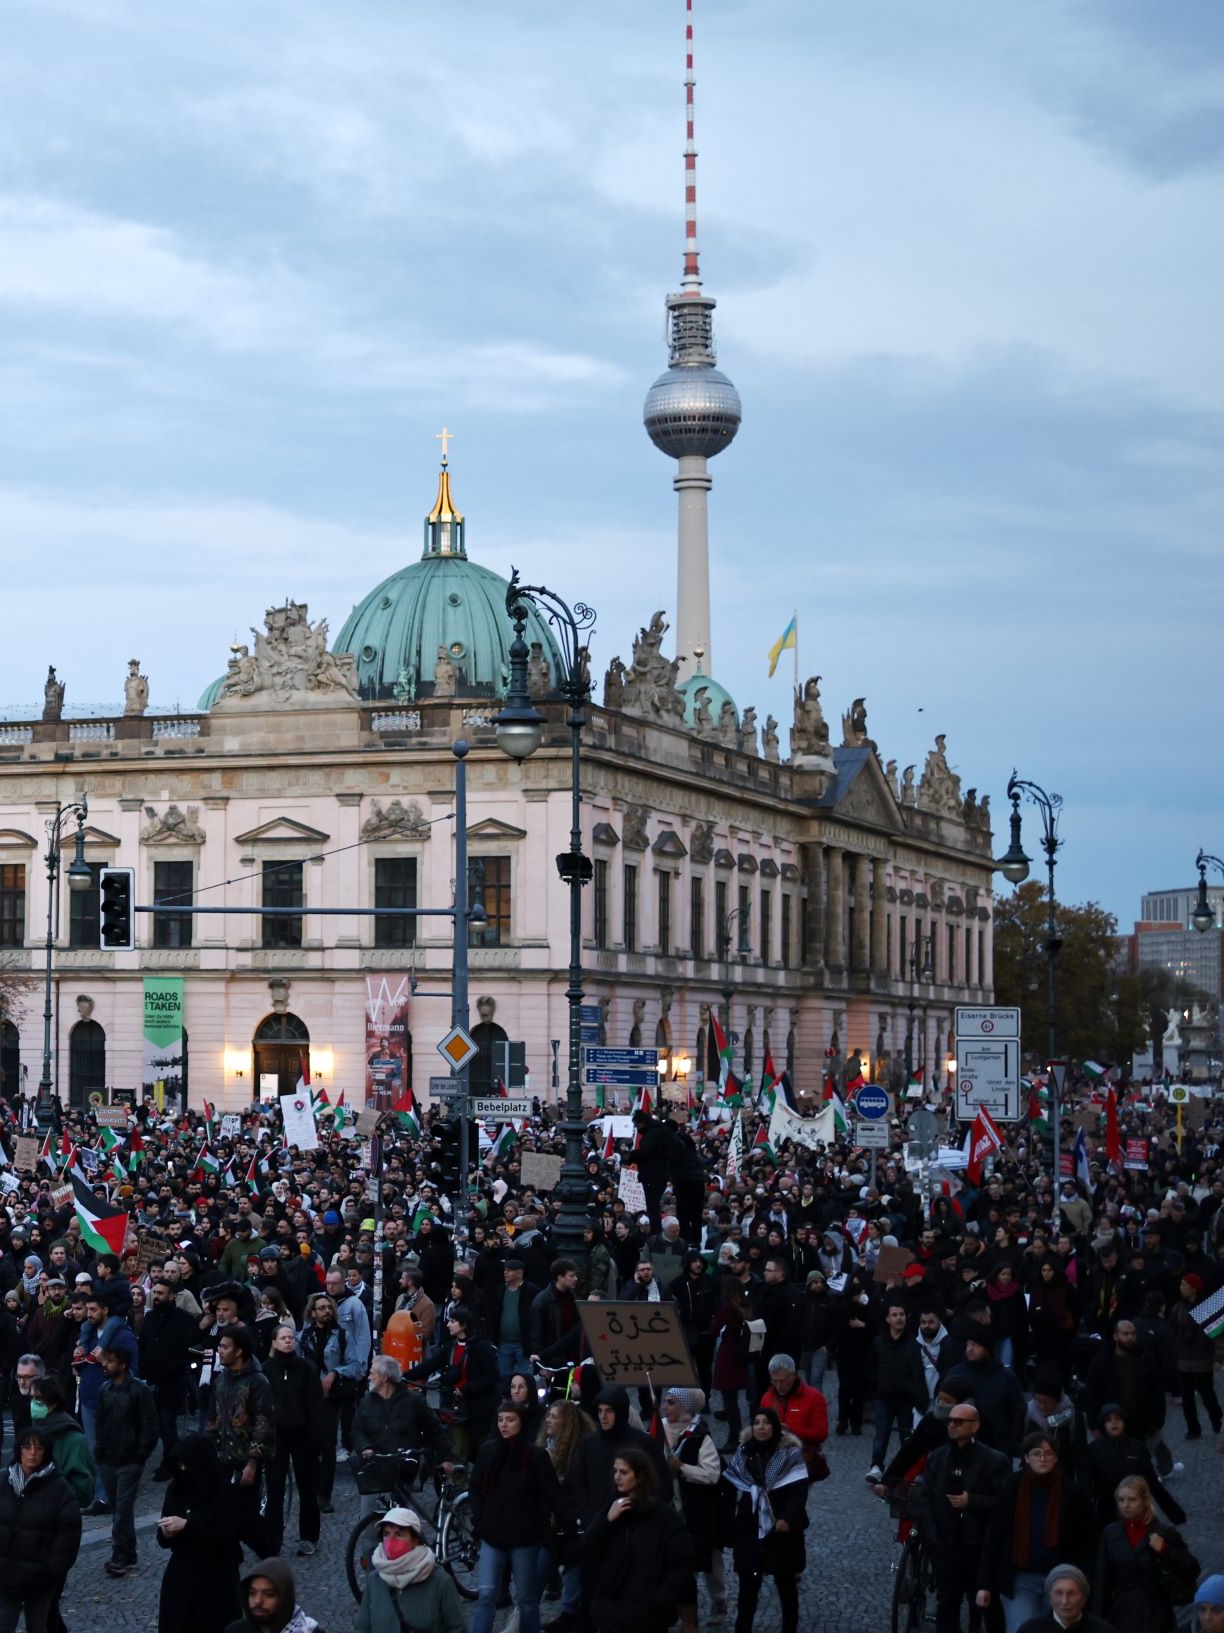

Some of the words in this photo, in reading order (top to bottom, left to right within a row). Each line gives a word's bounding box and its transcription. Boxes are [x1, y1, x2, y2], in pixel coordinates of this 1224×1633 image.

[144, 992, 178, 1001] ROADS
[149, 1002, 181, 1011] TAKEN
[960, 1012, 988, 1020] Eiserne
[989, 1012, 1015, 1020] Brücke
[367, 1022, 405, 1032] Biermann
[970, 1054, 1002, 1062] Lustgarten
[477, 1102, 527, 1113] Bebelplatz
[606, 1309, 671, 1340] غزة
[598, 1350, 684, 1382] حبيبتي
